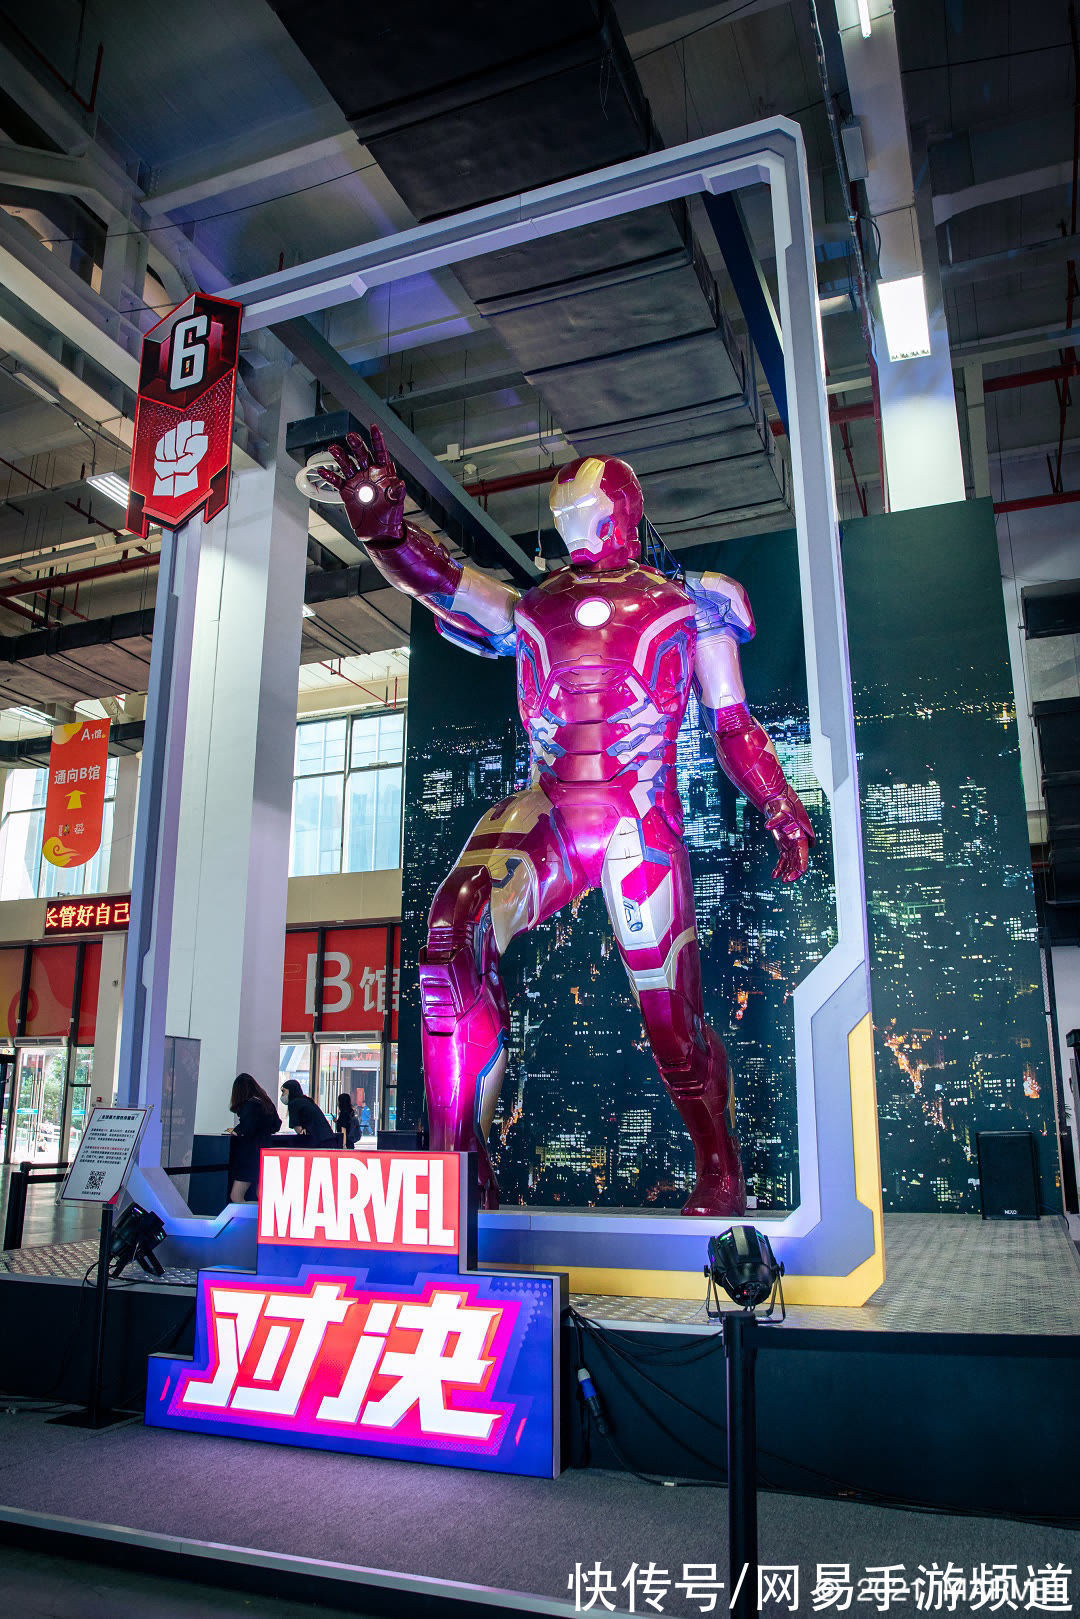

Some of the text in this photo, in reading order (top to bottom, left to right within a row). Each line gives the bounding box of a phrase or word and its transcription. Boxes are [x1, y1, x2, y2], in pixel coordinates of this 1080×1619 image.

[169, 314, 208, 390] 6
[54, 765, 101, 785] 通向B馆
[260, 1155, 455, 1246] MARVEL
[182, 1283, 503, 1439] 对决
